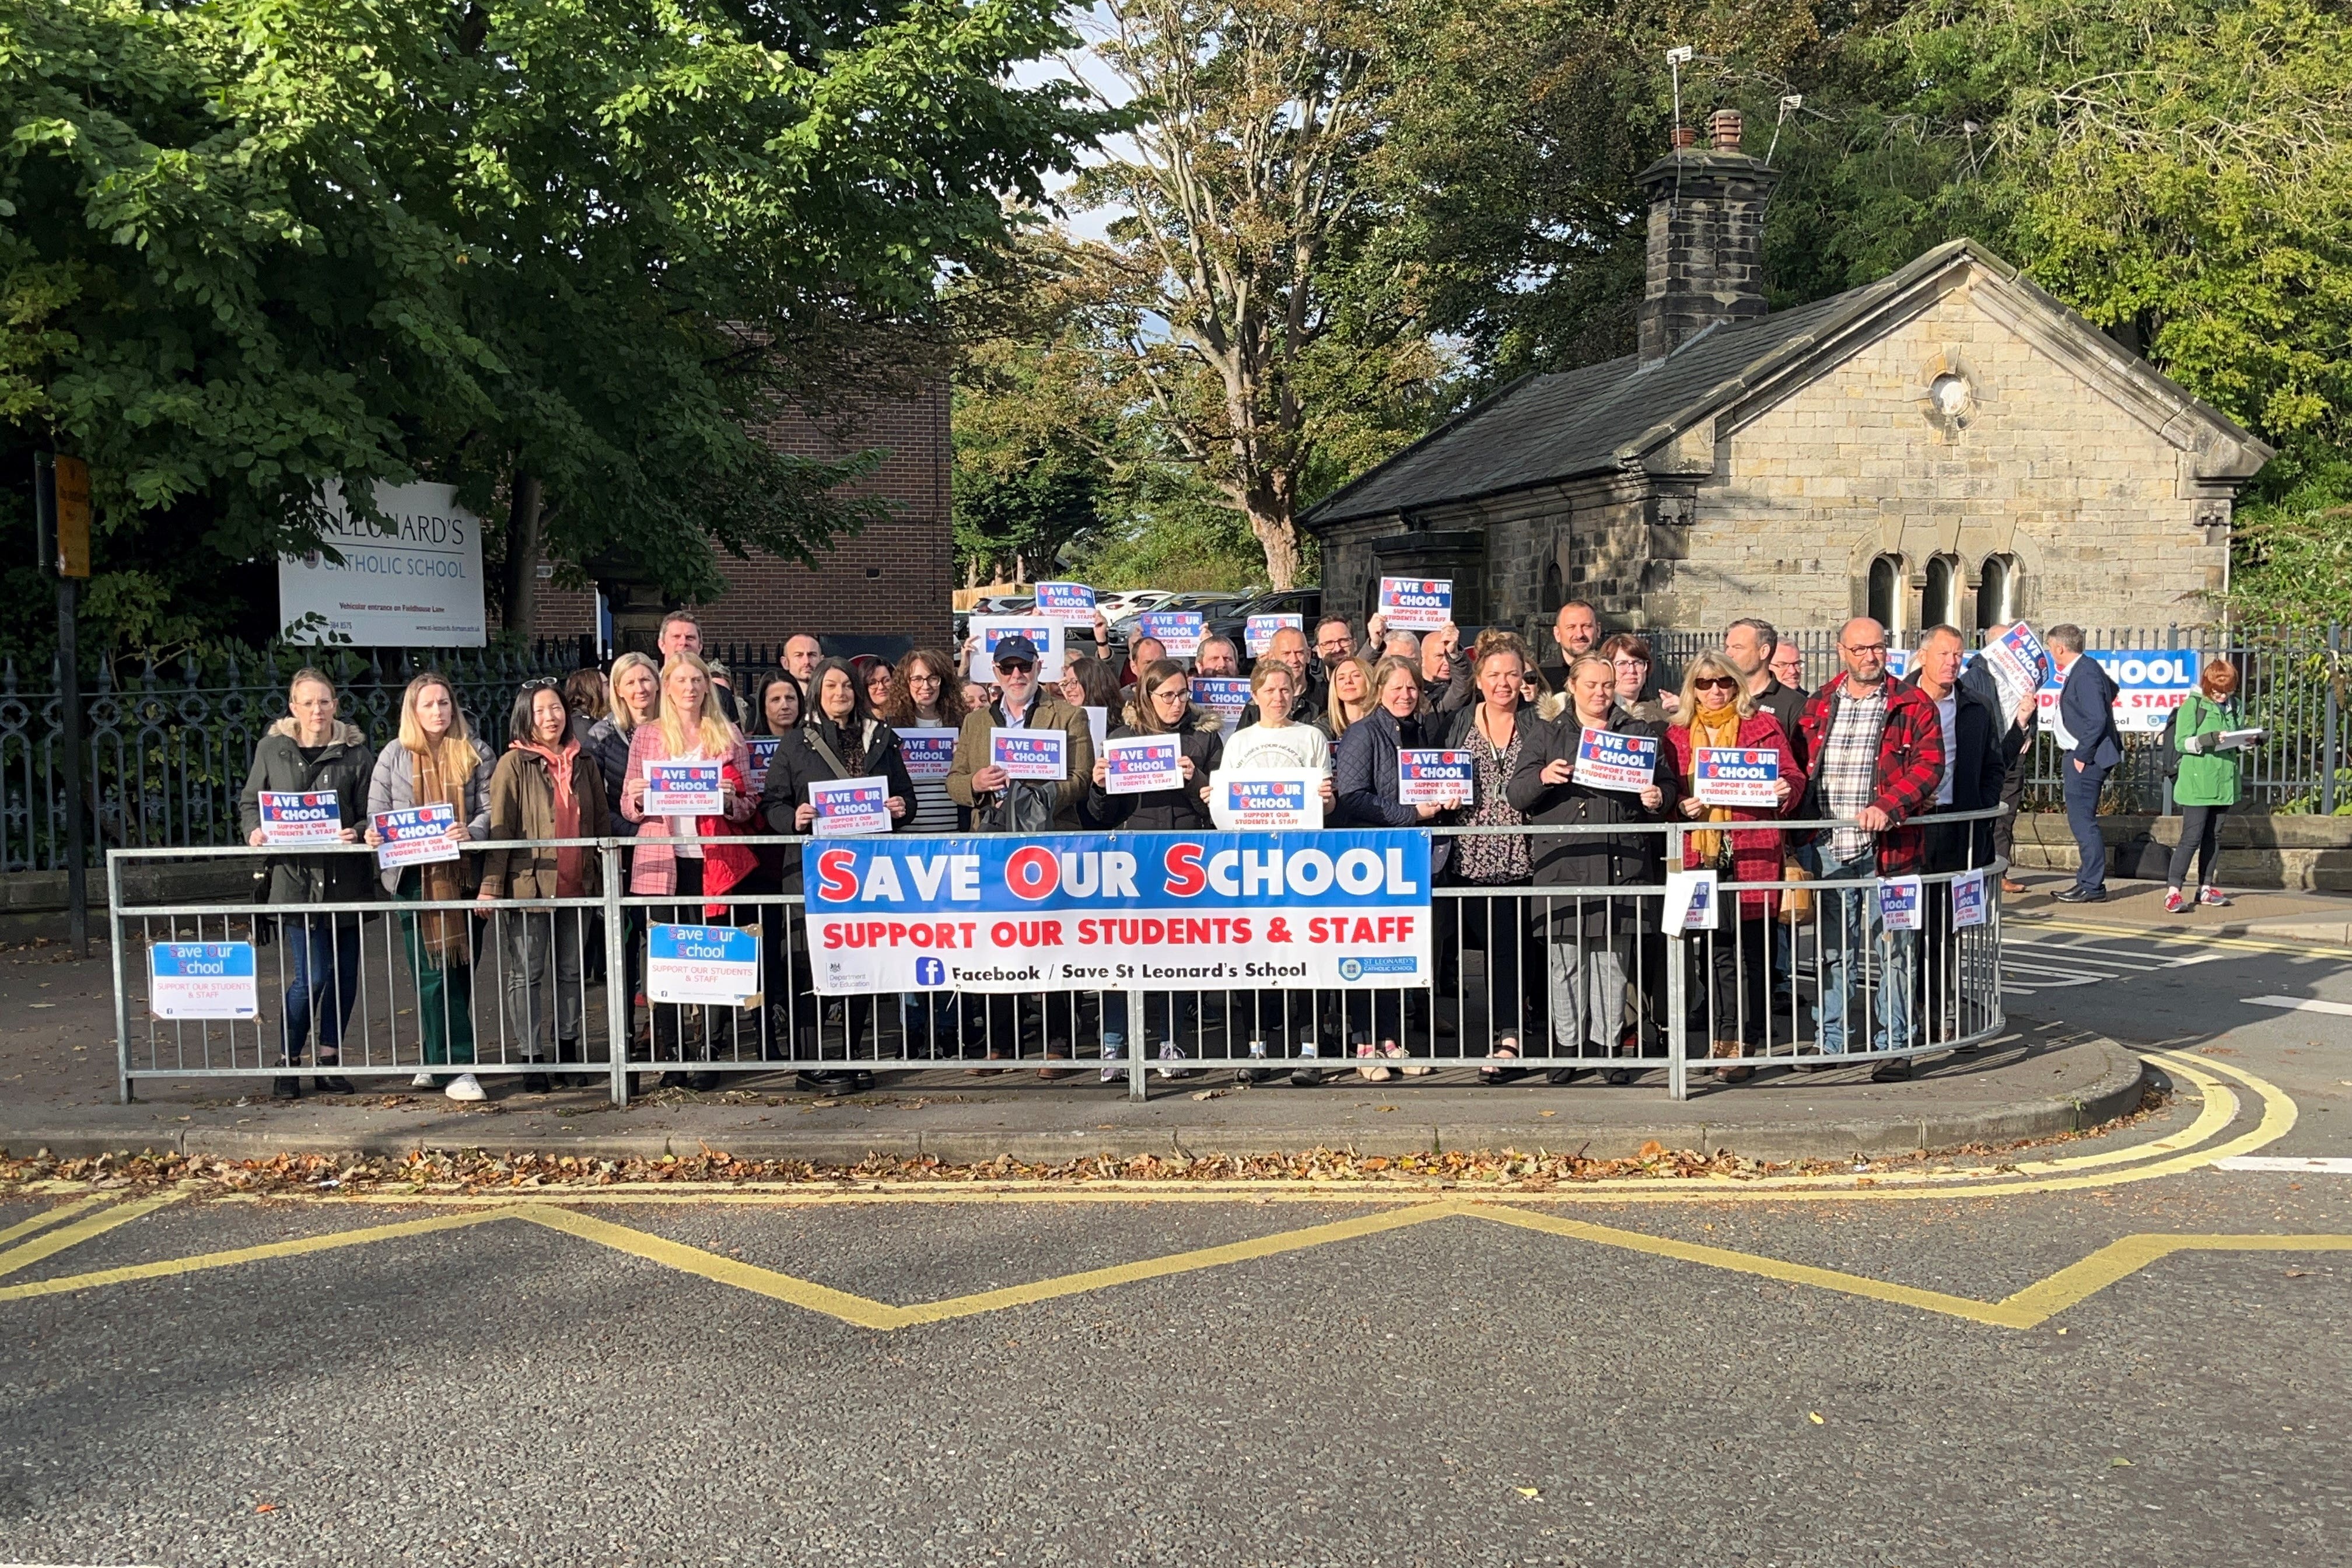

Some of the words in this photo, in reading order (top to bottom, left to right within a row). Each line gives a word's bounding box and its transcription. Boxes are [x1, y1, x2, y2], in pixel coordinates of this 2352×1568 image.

[407, 558, 466, 578] SCHOOL
[1041, 586, 1069, 596] SAVE
[1072, 587, 1092, 598] OUR
[1384, 580, 1419, 593] SAVE
[1423, 582, 1450, 594] OUR
[1047, 596, 1088, 606] SCHOOL
[1391, 593, 1441, 607] SCHOOL
[1144, 615, 1172, 625] SAVE
[1176, 614, 1199, 625] OUR
[1249, 619, 1274, 628] SAVE
[1277, 618, 1298, 627] OUR
[1023, 629, 1046, 640] OUR
[1150, 626, 1193, 636] SCHOOL
[2014, 625, 2041, 657] SAVE
[2009, 639, 2041, 685] SCHOOL
[1196, 681, 1224, 692] SAVE
[1228, 682, 1251, 692] OUR
[1202, 692, 1245, 703] SCHOOL
[899, 740, 925, 750] AVE
[928, 739, 951, 750] OUR
[998, 738, 1029, 750] SAVE
[1032, 740, 1058, 752] OUR
[1584, 730, 1623, 750] SAVE
[1627, 738, 1654, 752] OUR
[902, 750, 944, 760] SCHOOL
[1005, 750, 1051, 762] SCHOOL
[1111, 750, 1143, 761] SAVE
[1147, 747, 1172, 759] OUR
[1279, 745, 1298, 756] HEART
[1589, 746, 1646, 766] SCHOOL
[1402, 752, 1438, 764] SAVE
[1442, 752, 1470, 764] OUR
[1699, 751, 1740, 764] SAVE
[1744, 751, 1776, 765] OUR
[1119, 761, 1166, 772] SCHOOL
[1410, 765, 1464, 778] SCHOOL
[1591, 764, 1623, 774] SUPPORT
[1707, 764, 1767, 779] SCHOOL
[652, 768, 686, 779] SAVE
[690, 768, 716, 780] OUR
[1581, 769, 1616, 780] STUDENTS
[660, 780, 709, 790] SCHOOL
[1233, 783, 1268, 796] SAVE
[1272, 783, 1301, 796] OUR
[262, 794, 299, 807] SAVE
[303, 794, 336, 807] OUR
[816, 792, 850, 804] SAVE
[854, 789, 880, 802] OUR
[1240, 796, 1293, 808] SCHOOL
[272, 808, 329, 820] SCHOOL
[826, 803, 873, 816] SCHOOL
[377, 813, 416, 827] SAVE
[419, 809, 452, 822] OUR
[387, 823, 444, 840] SCHOOL
[393, 841, 425, 849] SUPPORT
[386, 848, 421, 858] STUDENTS
[818, 849, 981, 902] SAVE
[1005, 845, 1140, 901] OUR
[1163, 843, 1416, 897] SCHOOL
[669, 926, 703, 940] Save
[709, 928, 735, 942] Our
[824, 922, 976, 950] SUPPORT
[991, 920, 1064, 947] OUR
[1078, 918, 1252, 944] STUDENTS
[1267, 917, 1293, 943] &
[1309, 916, 1414, 944] STAFF
[169, 945, 202, 957] Save
[206, 944, 232, 957] Our
[678, 943, 724, 958] School
[179, 960, 224, 974] School
[710, 968, 752, 976] STUDENTS
[952, 965, 1040, 981] Facebook
[1049, 964, 1054, 979] /
[1062, 964, 1109, 978] Save
[1116, 964, 1134, 978] St
[1143, 963, 1237, 978] Leonard's
[1245, 962, 1306, 977] School
